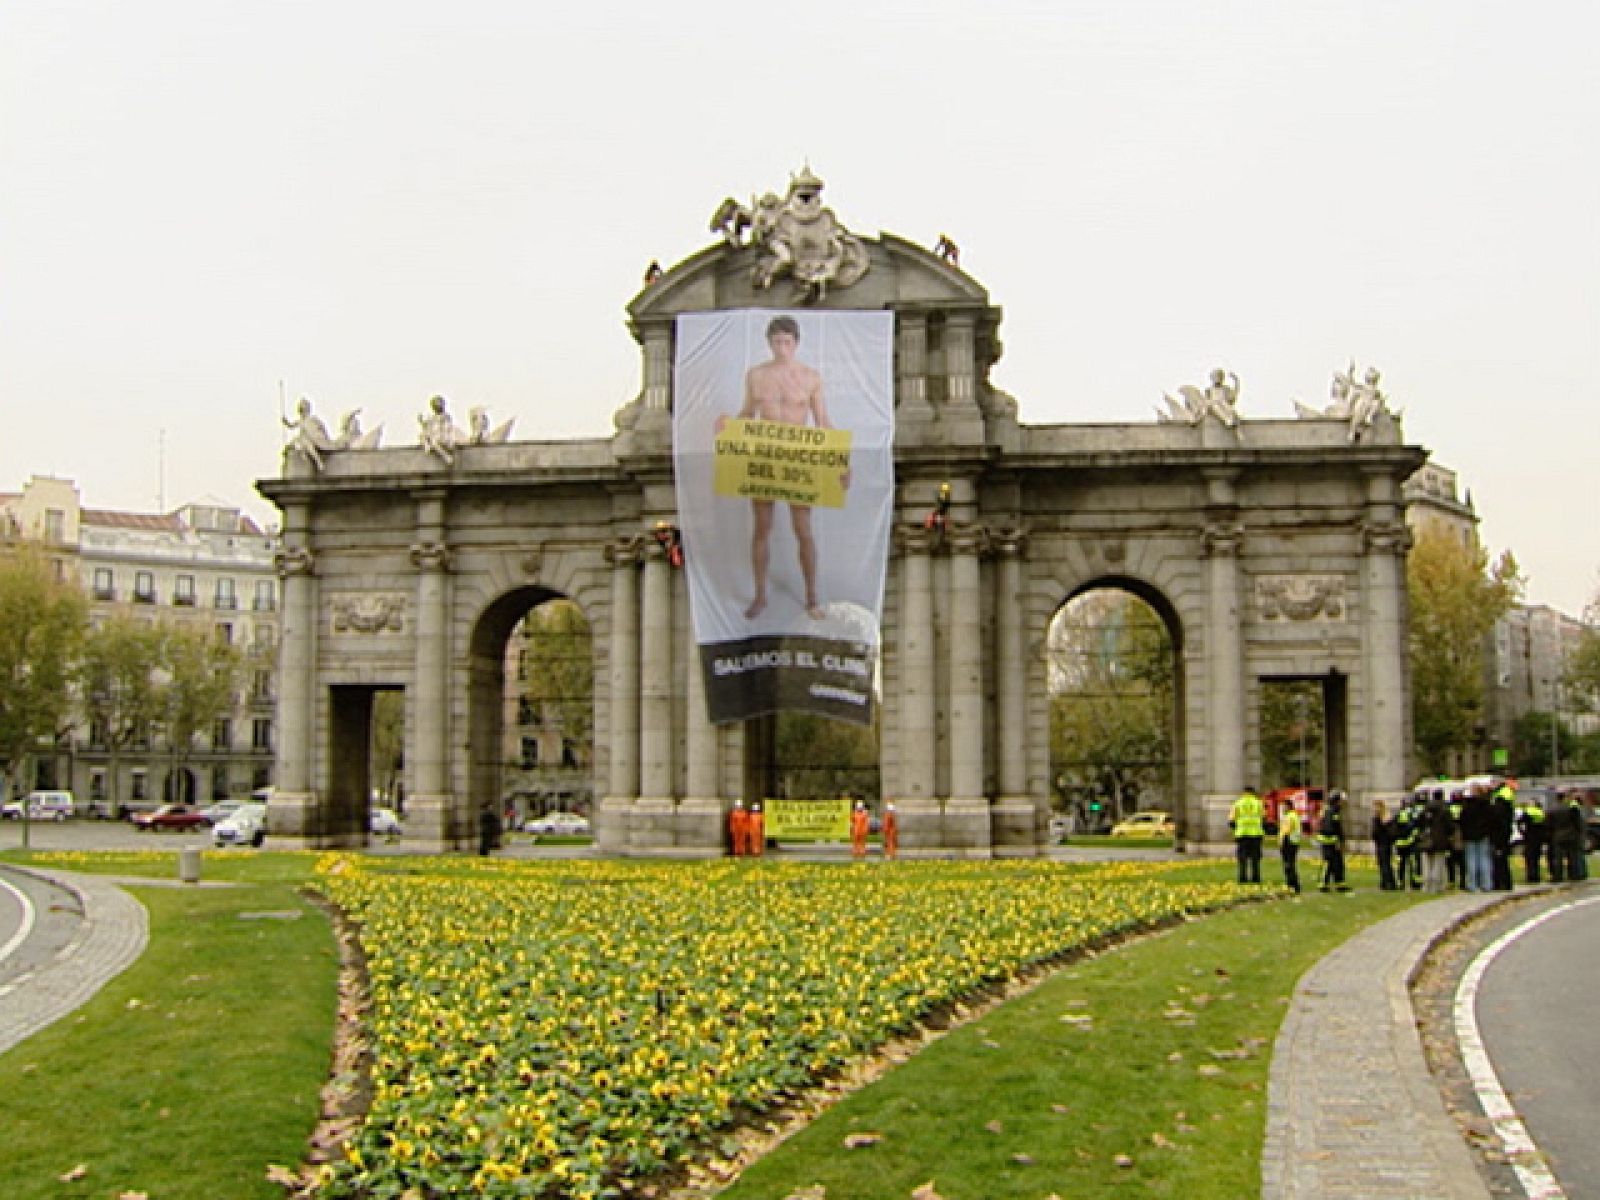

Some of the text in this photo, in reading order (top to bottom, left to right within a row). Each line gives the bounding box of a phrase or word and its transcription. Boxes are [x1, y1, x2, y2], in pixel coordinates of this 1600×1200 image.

[744, 422, 826, 446] NECESITO
[715, 438, 750, 456] UNA
[747, 461, 776, 481] DEL
